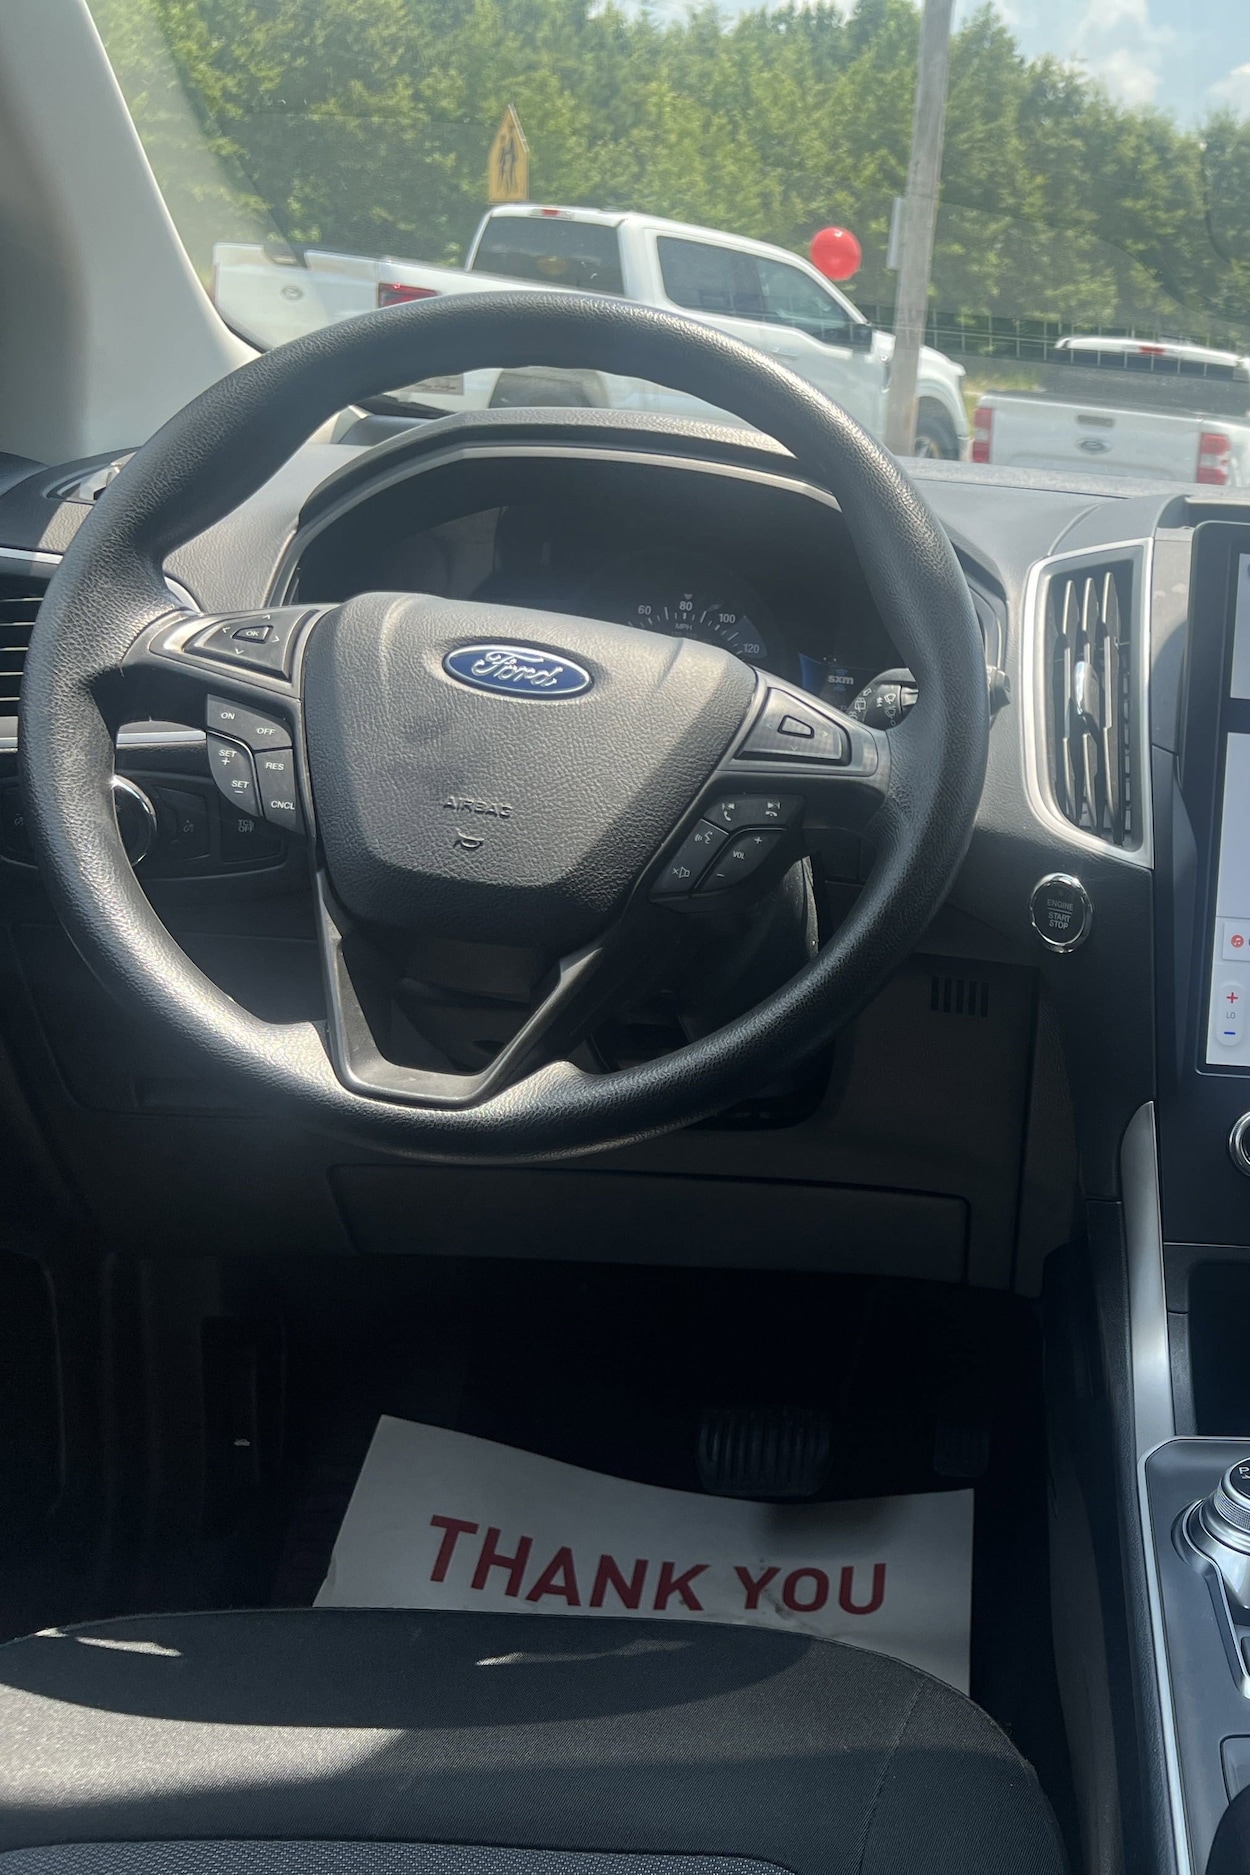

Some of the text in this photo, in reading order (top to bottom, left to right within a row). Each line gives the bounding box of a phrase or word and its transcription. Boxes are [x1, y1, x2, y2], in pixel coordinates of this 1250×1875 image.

[638, 605, 652, 616] 60
[679, 601, 693, 612] 80
[718, 613, 736, 624] 100
[246, 630, 260, 638] OK
[743, 643, 760, 655] 120
[471, 649, 563, 688] Ford
[828, 675, 854, 686] sxm
[220, 712, 235, 720] ON
[256, 728, 276, 737] OFF
[218, 749, 236, 758] SET
[265, 762, 284, 771] RES
[231, 780, 249, 789] SET
[271, 801, 295, 811] CNCL
[442, 796, 514, 820] AIRBAG
[732, 851, 745, 860] VOL
[1047, 899, 1074, 911] ENGINE
[1048, 911, 1071, 923] START
[1048, 920, 1069, 930] STOP
[1226, 1011, 1236, 1020] LO
[1239, 1467, 1250, 1475] P
[430, 1514, 887, 1616] THANK YOU
